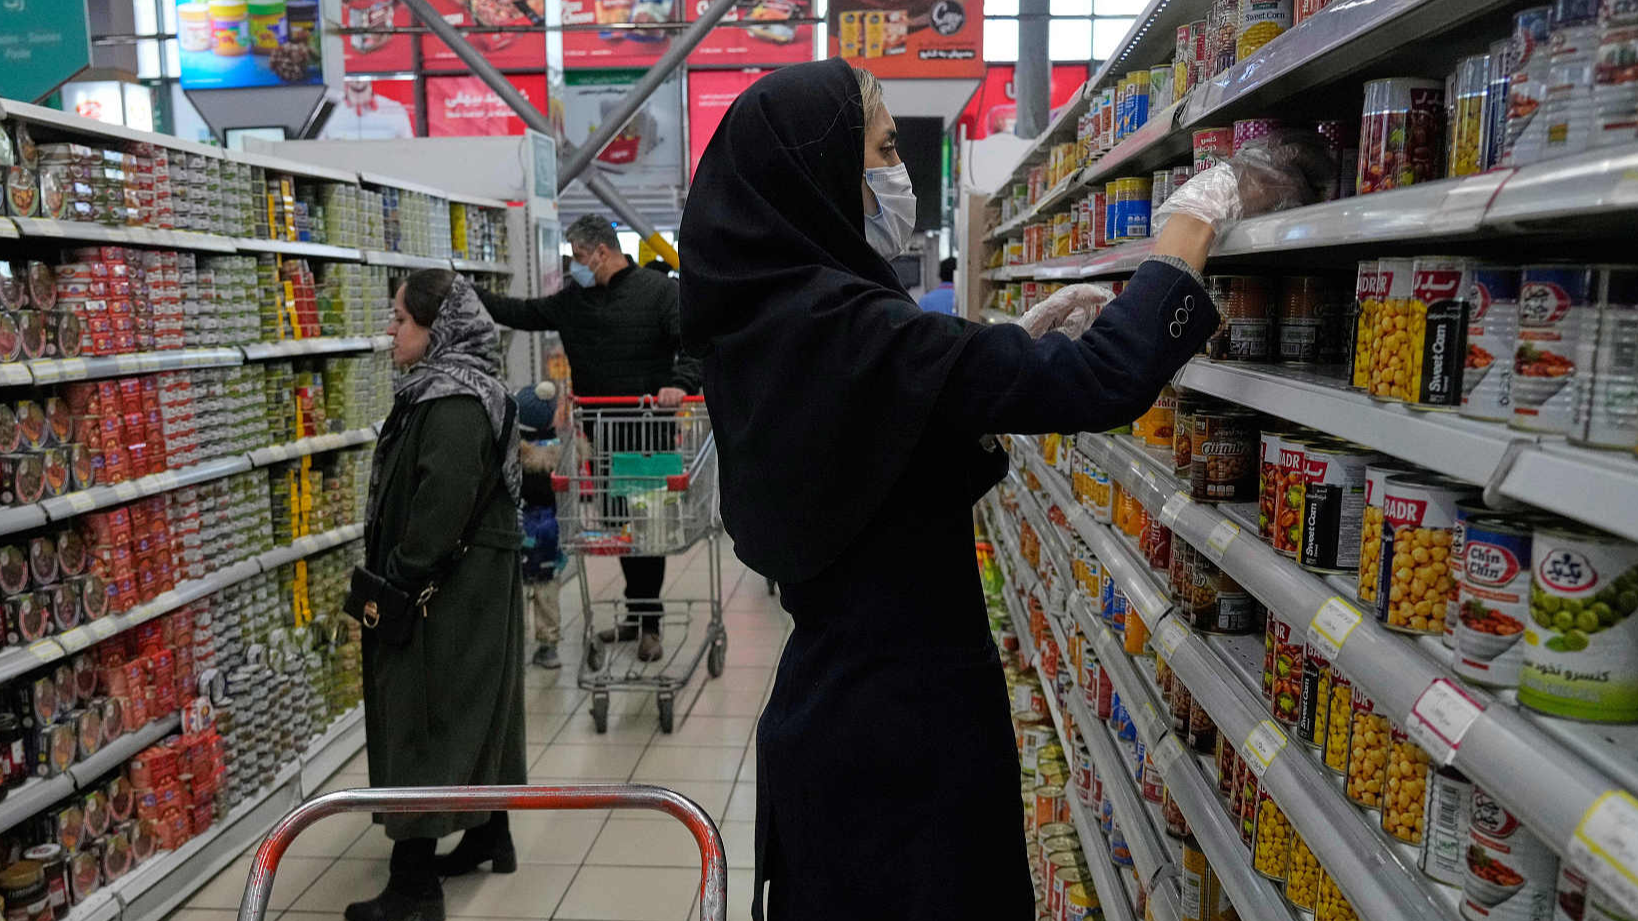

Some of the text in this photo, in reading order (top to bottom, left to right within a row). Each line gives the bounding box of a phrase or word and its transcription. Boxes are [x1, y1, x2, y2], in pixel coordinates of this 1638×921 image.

[1245, 11, 1285, 22] Sweet Corn
[1432, 323, 1446, 354] Corn
[1429, 354, 1445, 391] Sweet
[1280, 452, 1300, 469] ADR
[1308, 502, 1317, 526] Corn
[1384, 498, 1418, 522] BADR
[1305, 525, 1316, 556] Sweet
[1470, 546, 1501, 564] Chin
[1470, 563, 1501, 579] Chin
[1564, 669, 1611, 683] کنسرو
[1301, 677, 1310, 729] Sweet Corn
